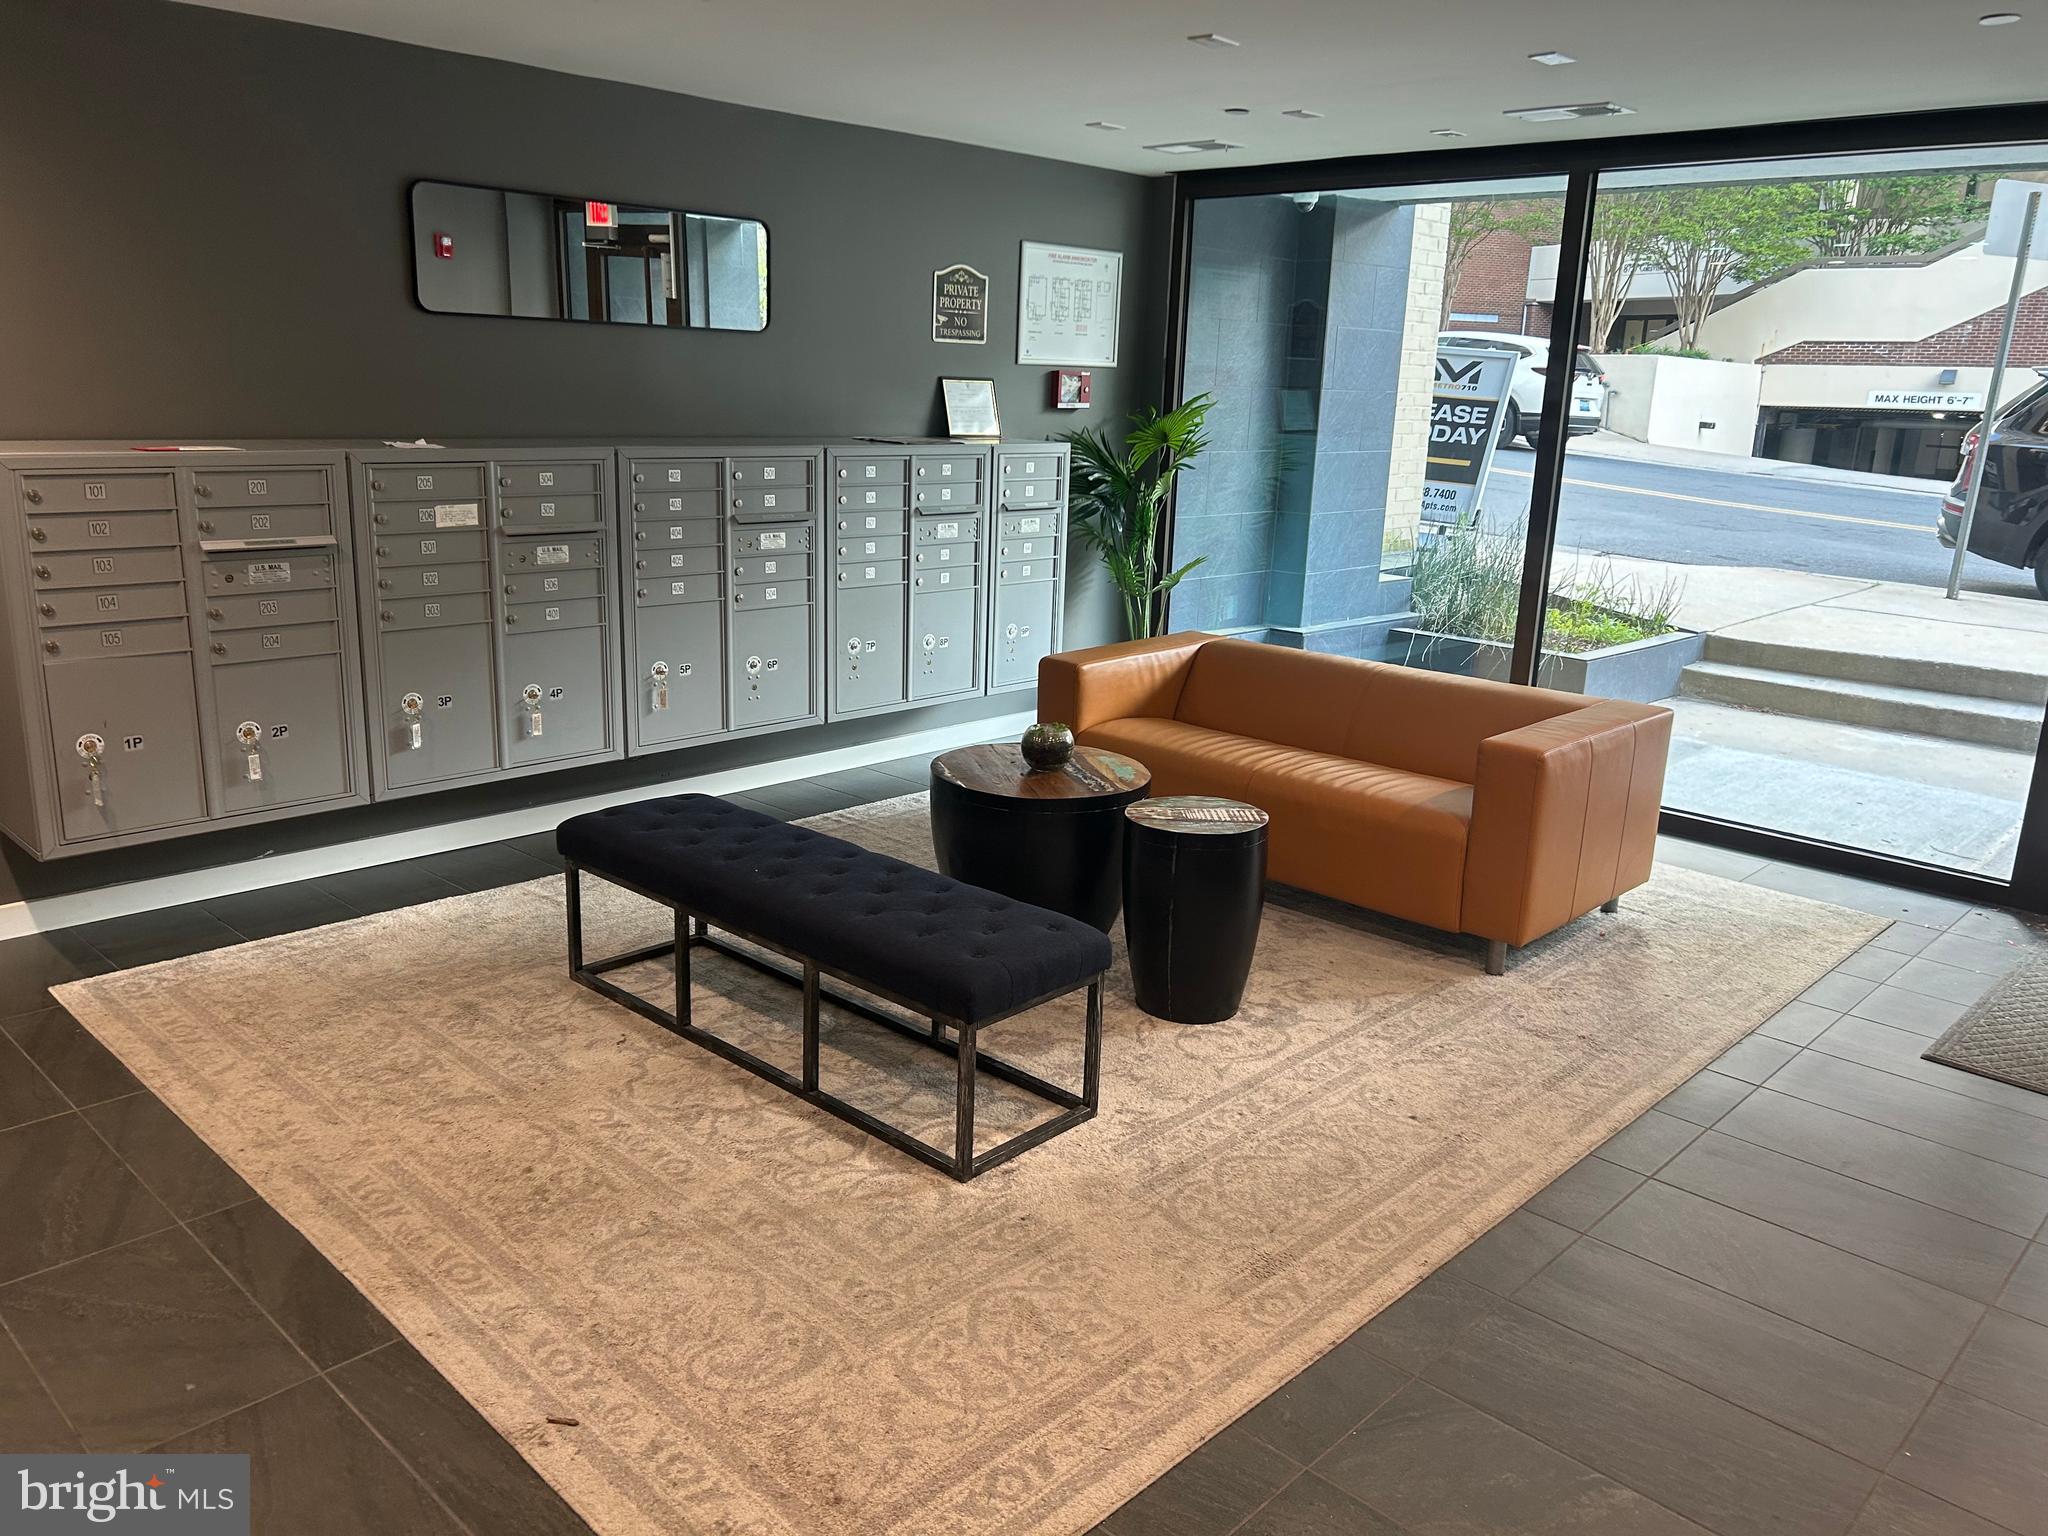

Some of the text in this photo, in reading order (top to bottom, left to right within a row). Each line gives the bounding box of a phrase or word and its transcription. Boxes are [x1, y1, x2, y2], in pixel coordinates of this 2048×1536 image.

[944, 283, 979, 297] PRIVATE
[940, 296, 982, 310] PROPERTY
[954, 316, 967, 327] NO
[940, 328, 981, 338] TRESPASSING
[1874, 394, 1974, 405] MAX HEIGHT 6'-7"
[1430, 424, 1487, 445] DAY
[540, 474, 553, 485] 304
[669, 471, 681, 481] 402
[250, 481, 266, 493] 201
[417, 477, 432, 489] 205
[88, 485, 104, 498] 101
[1423, 486, 1457, 500] 8.7400
[670, 500, 681, 509] 403
[419, 510, 434, 521] 206
[252, 516, 270, 528] 202
[91, 522, 108, 535] 102
[671, 528, 682, 538] 404
[422, 542, 436, 553] 301
[95, 559, 113, 572] 103
[671, 556, 683, 565] 405
[424, 573, 437, 584] 302
[672, 584, 684, 593] 406
[99, 596, 117, 609] 104
[260, 602, 277, 614] 203
[426, 605, 440, 616] 303
[546, 609, 559, 619] 401
[103, 633, 121, 645] 105
[263, 635, 280, 646] 204
[866, 642, 876, 650] 7P
[679, 665, 691, 674] 5P
[767, 660, 778, 669] 6P
[550, 688, 563, 698] 4P
[438, 696, 452, 707] 3P
[271, 725, 289, 738] 2P
[124, 737, 143, 750] 1P
